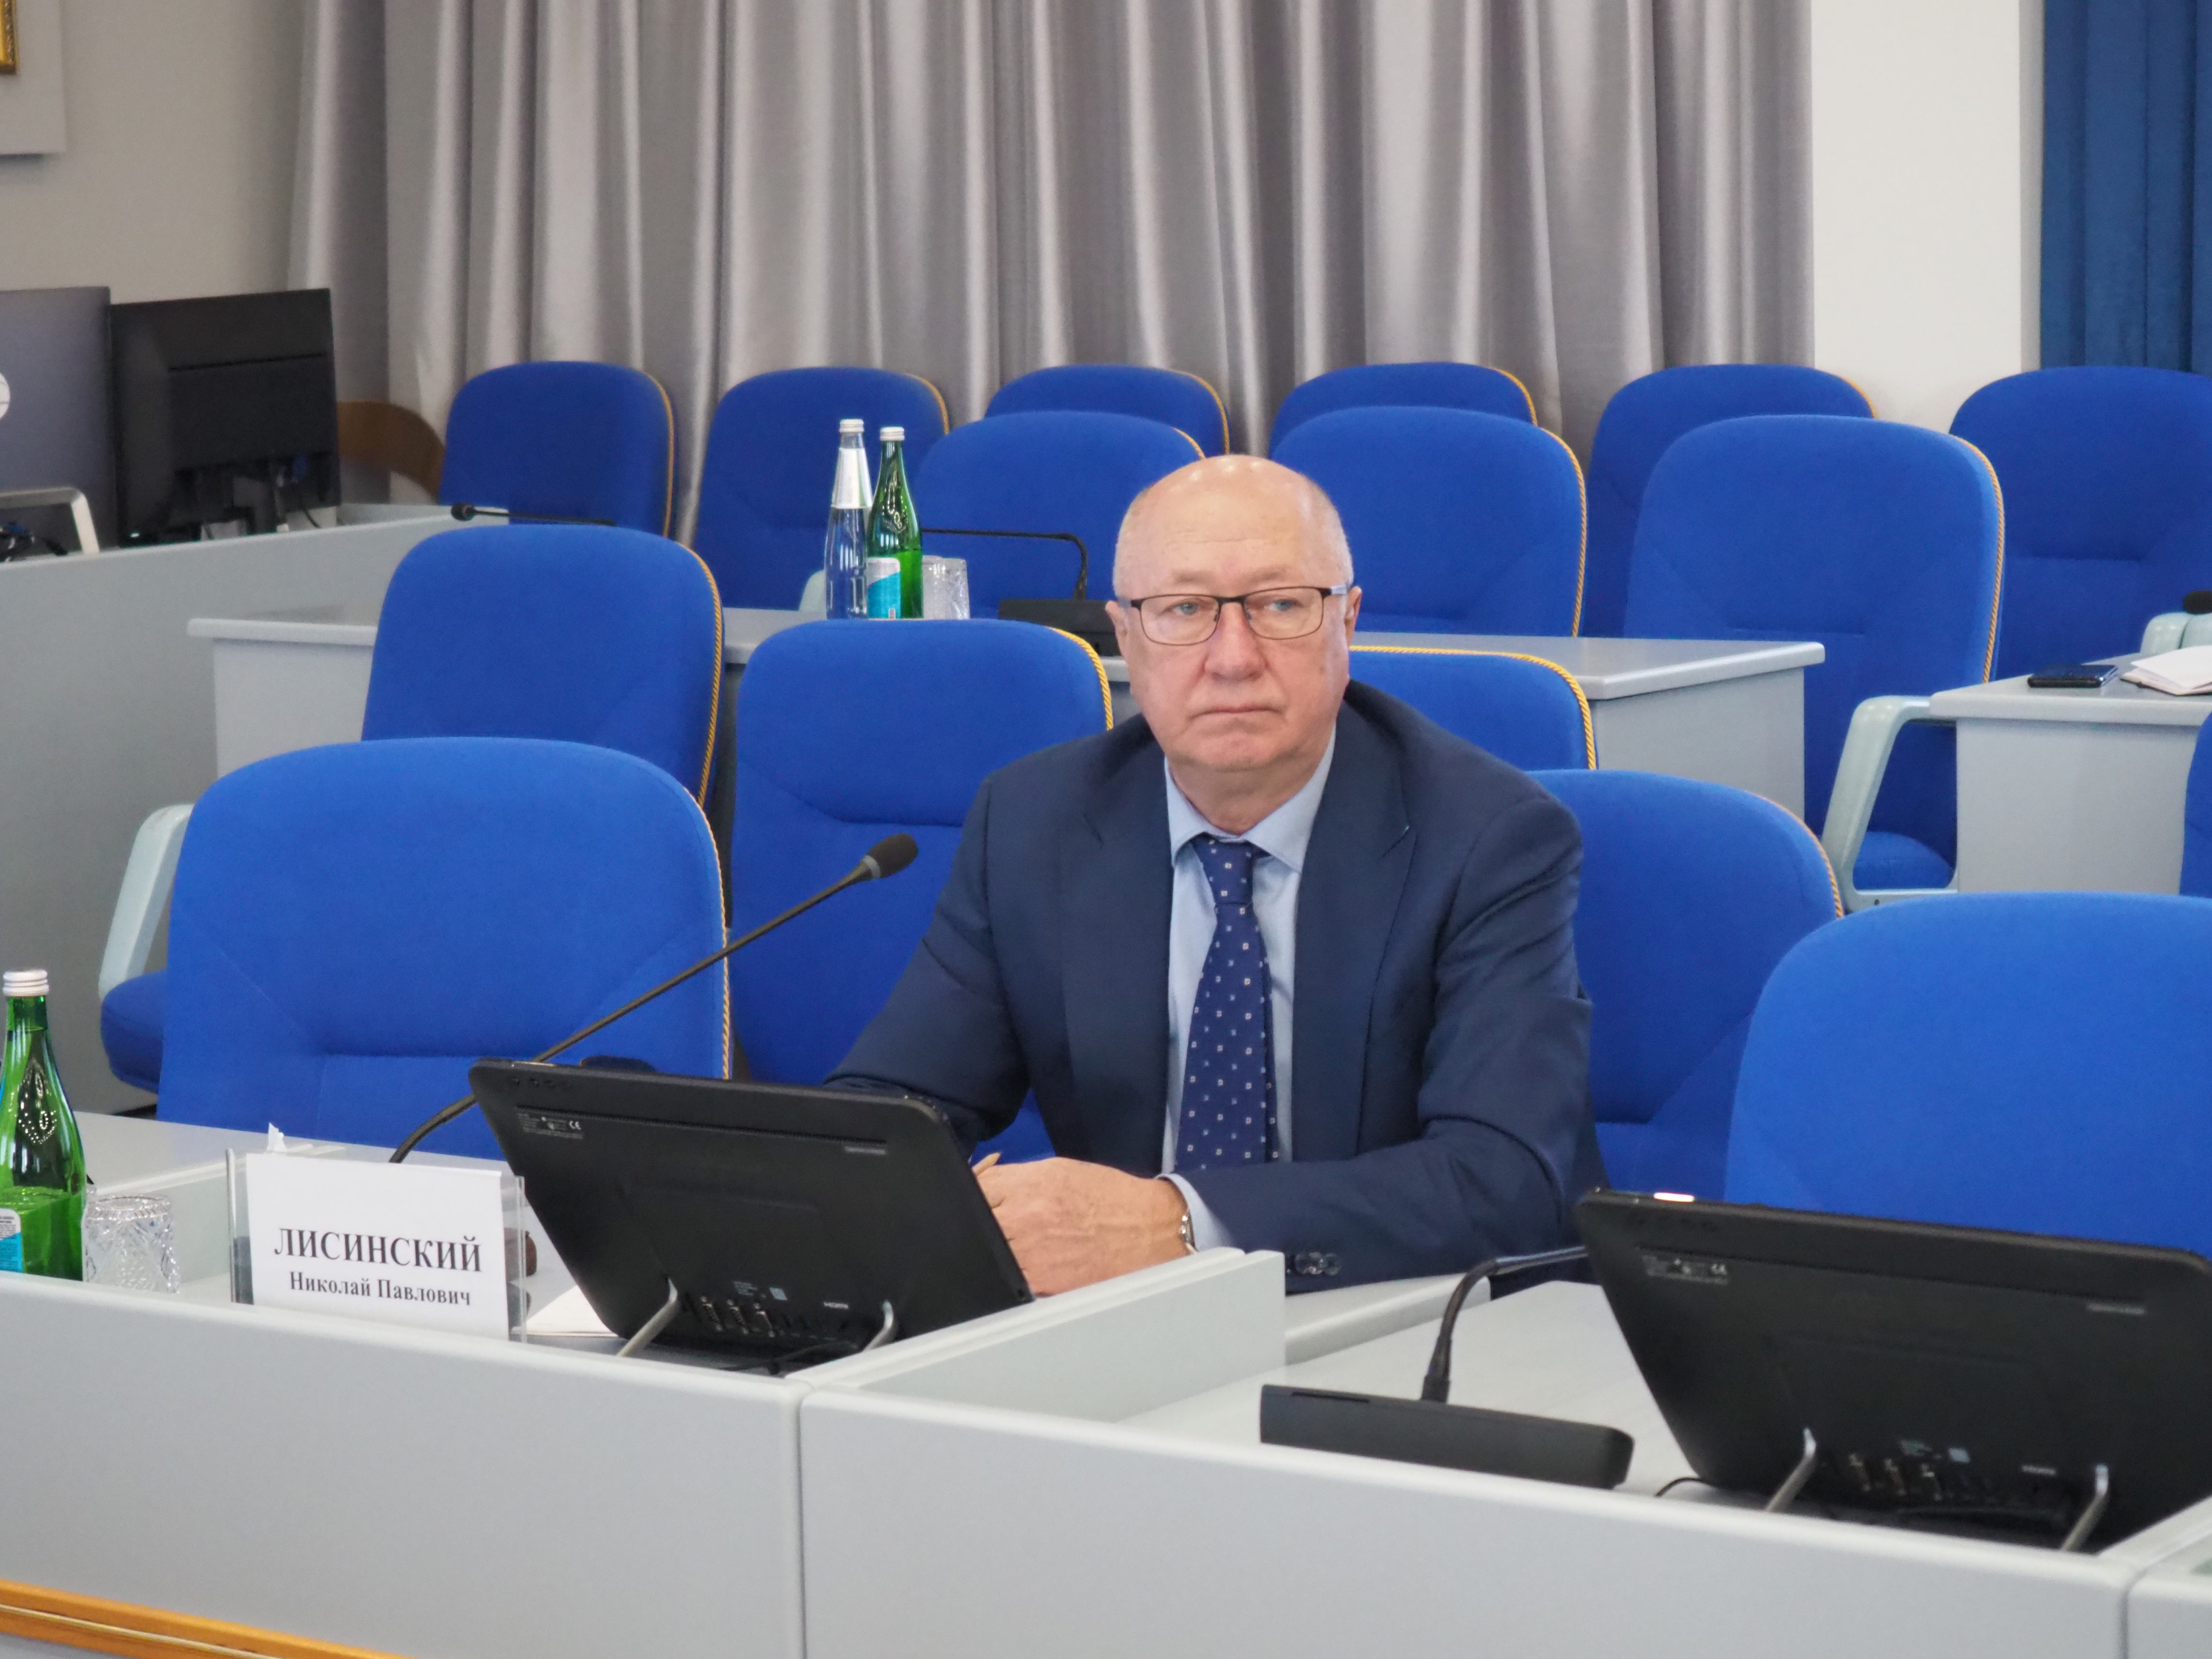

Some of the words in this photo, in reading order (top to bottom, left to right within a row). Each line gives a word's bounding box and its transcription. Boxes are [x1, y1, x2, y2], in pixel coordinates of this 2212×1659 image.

[274, 1228, 482, 1272] ЛИСИНСКИЙ
[290, 1271, 371, 1297] Николай
[377, 1279, 471, 1305] Павлович
